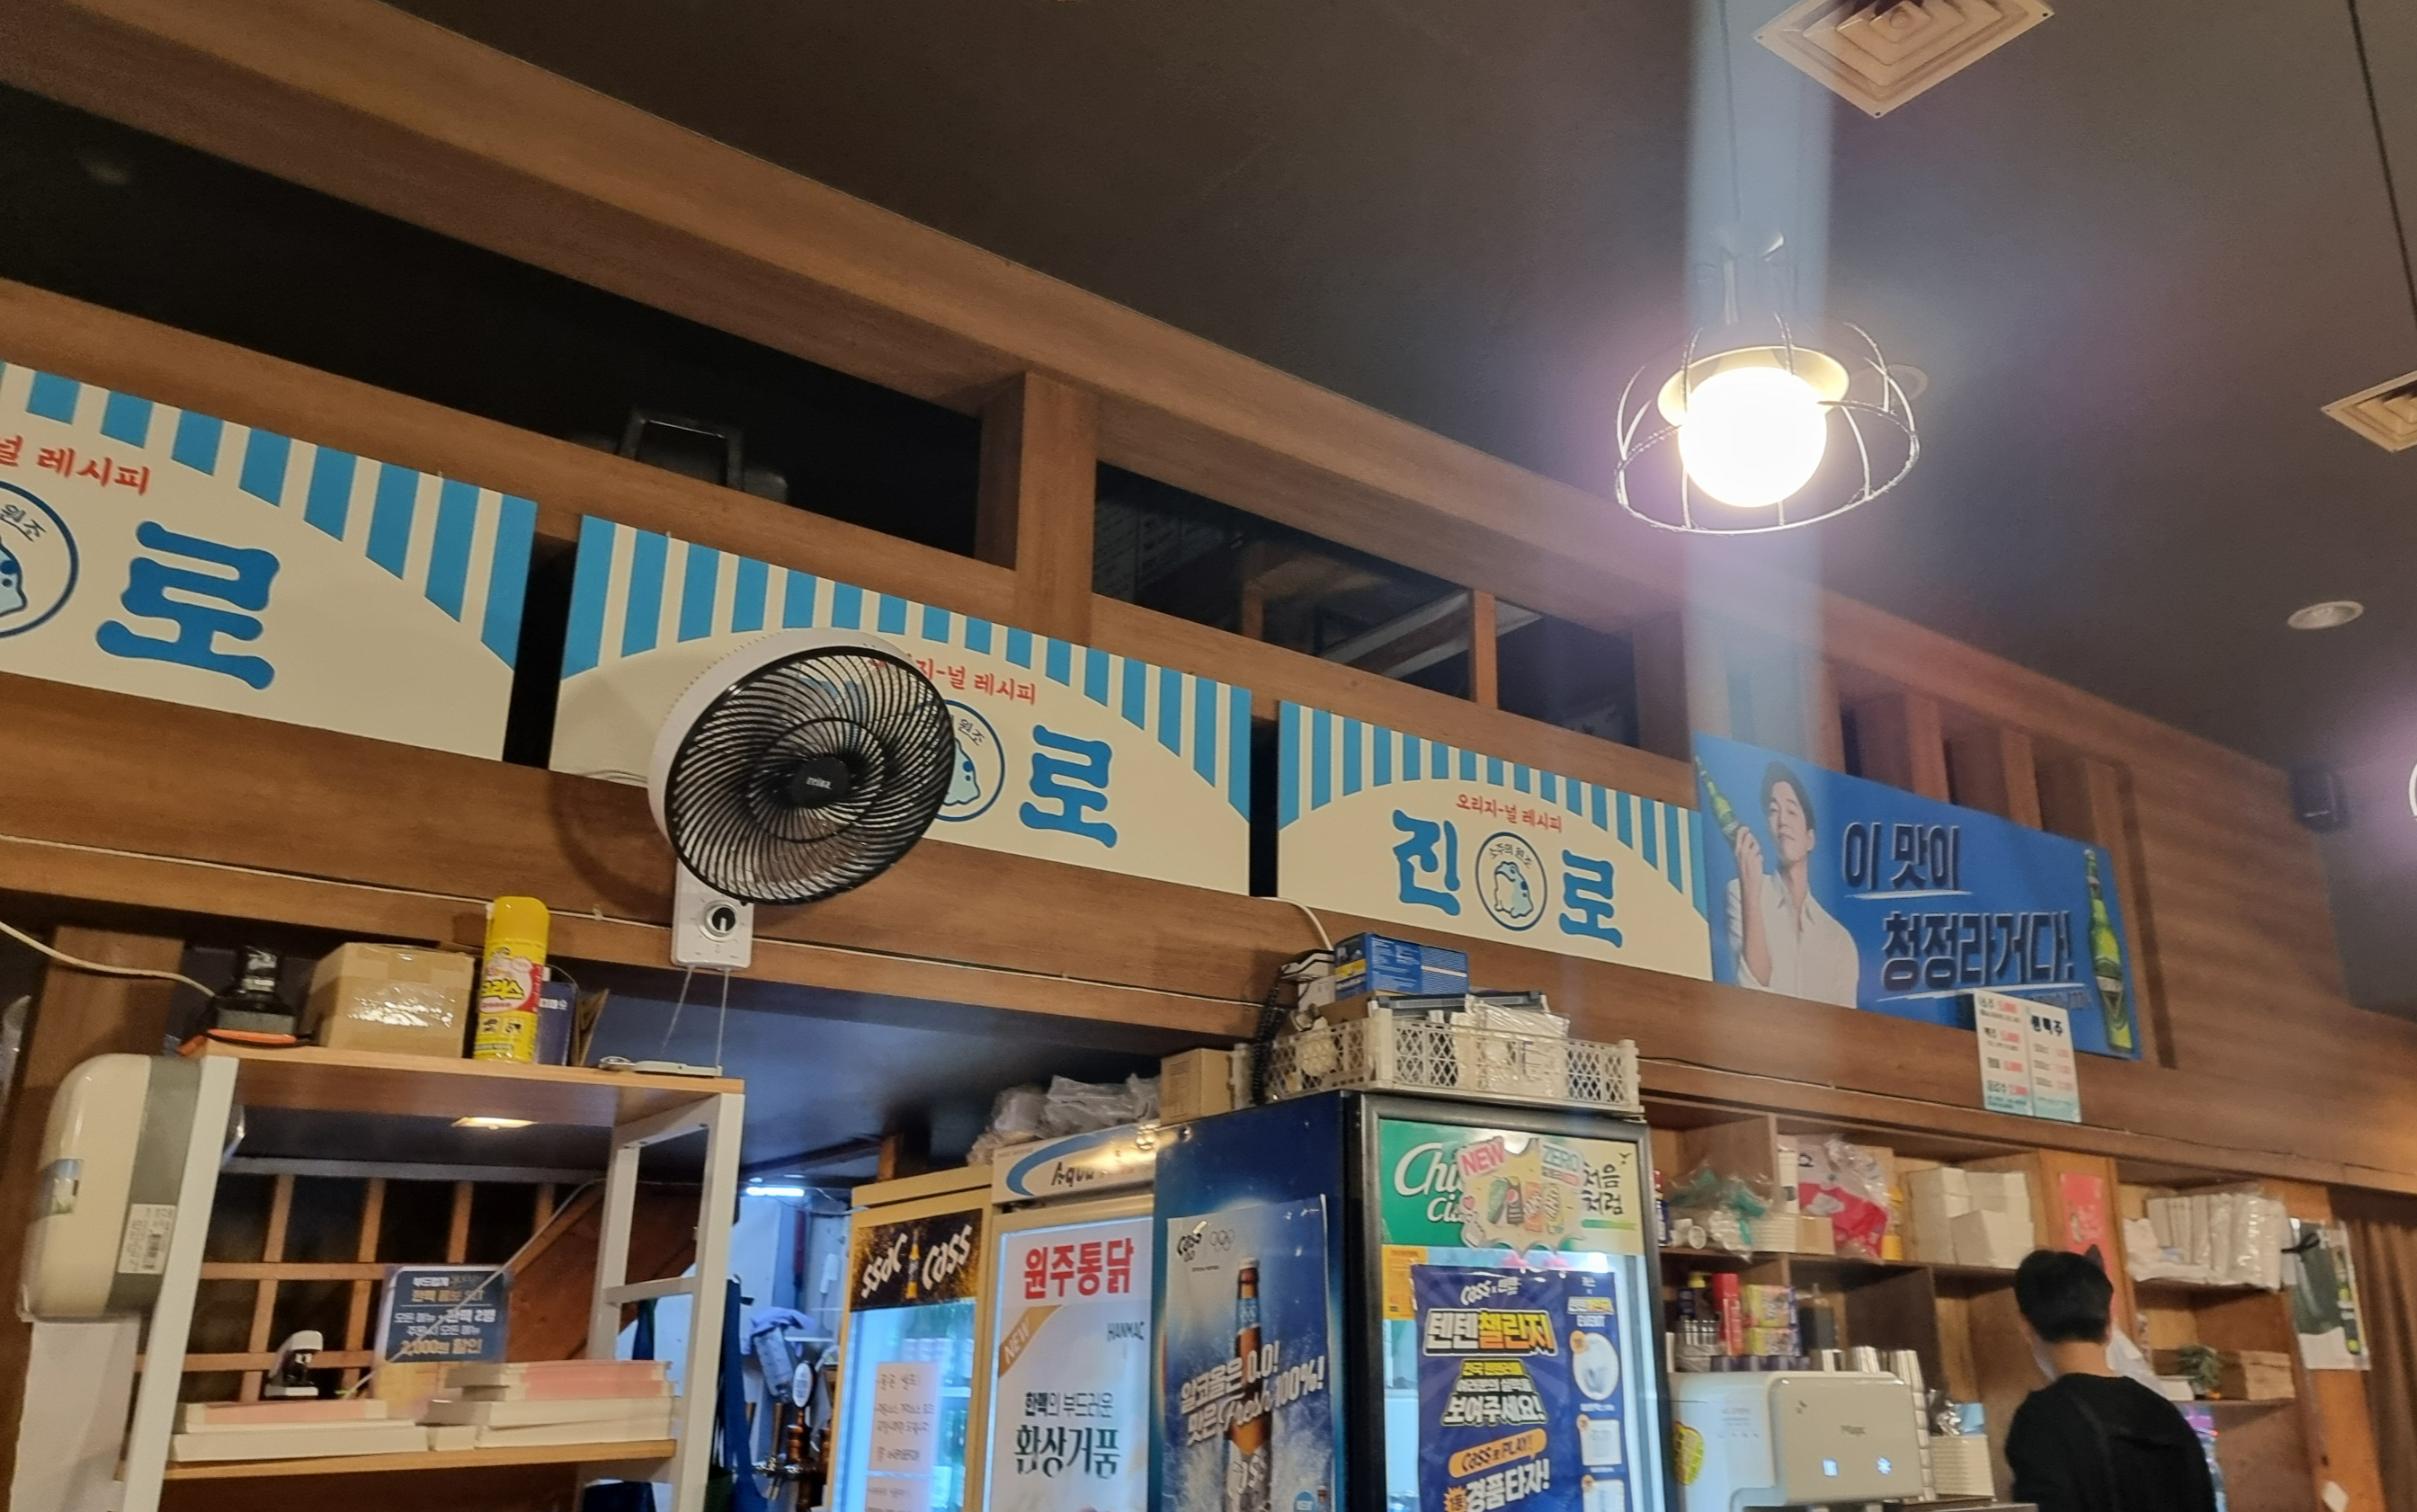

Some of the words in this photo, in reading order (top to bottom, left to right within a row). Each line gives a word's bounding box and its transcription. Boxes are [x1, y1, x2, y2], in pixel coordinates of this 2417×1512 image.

[38, 448, 150, 495] 레시피
[95, 520, 281, 690] 로
[974, 673, 1036, 705] 레시피
[1020, 725, 1117, 848] 로
[1456, 793, 1517, 823] 오리지-널
[1522, 809, 1562, 832] 레시피
[1392, 809, 1460, 916] 진
[1559, 849, 1622, 947] 로
[1843, 822, 1881, 890] 이
[1890, 823, 1960, 890] 맛이
[1881, 911, 2074, 991] 청정라거다!
[1460, 1143, 1505, 1176] NEW
[1024, 1238, 1135, 1300] 원주통닭
[1003, 1317, 1031, 1365] NEW
[1426, 1311, 1556, 1353] 텐텐챌린지
[1181, 1357, 1243, 1415] 알코올은
[1247, 1340, 1280, 1383] 0.0!
[1025, 1392, 1060, 1418] 한맥의
[1064, 1392, 1114, 1418] 부드러운
[1443, 1394, 1547, 1424] 보여주세요!
[1014, 1424, 1121, 1479] 환상거품
